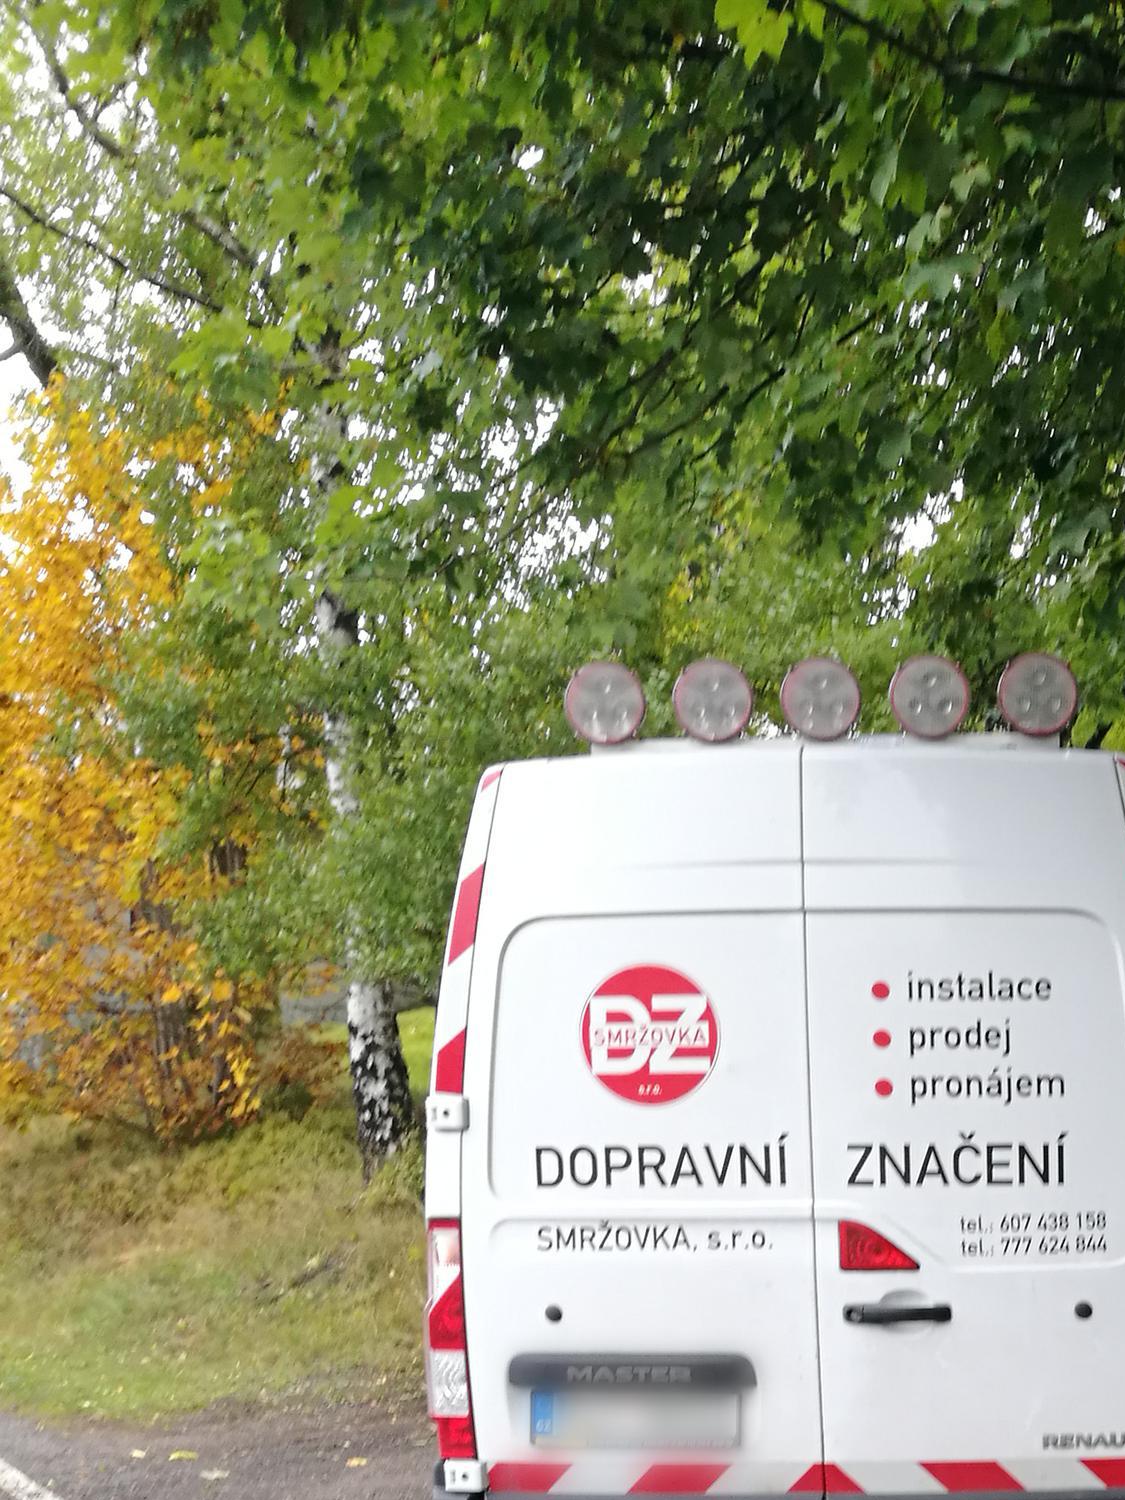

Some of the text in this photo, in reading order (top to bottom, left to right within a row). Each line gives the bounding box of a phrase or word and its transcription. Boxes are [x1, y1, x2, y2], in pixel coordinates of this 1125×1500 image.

[906, 971, 1052, 1001] instalace
[589, 993, 711, 1075] DZ
[593, 1023, 706, 1046] SMRŽOVKA
[909, 1018, 1012, 1056] prodej
[910, 1066, 1066, 1104] pronájem
[534, 1131, 1069, 1188] DOPRAVNÍ ZNAČENÍ
[537, 1219, 773, 1252] SMRŽOVKA, s.r.o.
[1000, 1212, 1031, 1233] 607
[1037, 1211, 1069, 1232] 438
[1076, 1210, 1107, 1231] 158
[1001, 1236, 1032, 1256] 777
[1038, 1235, 1069, 1255] 624
[1075, 1233, 1107, 1254] 844
[567, 1365, 692, 1385] MASTER
